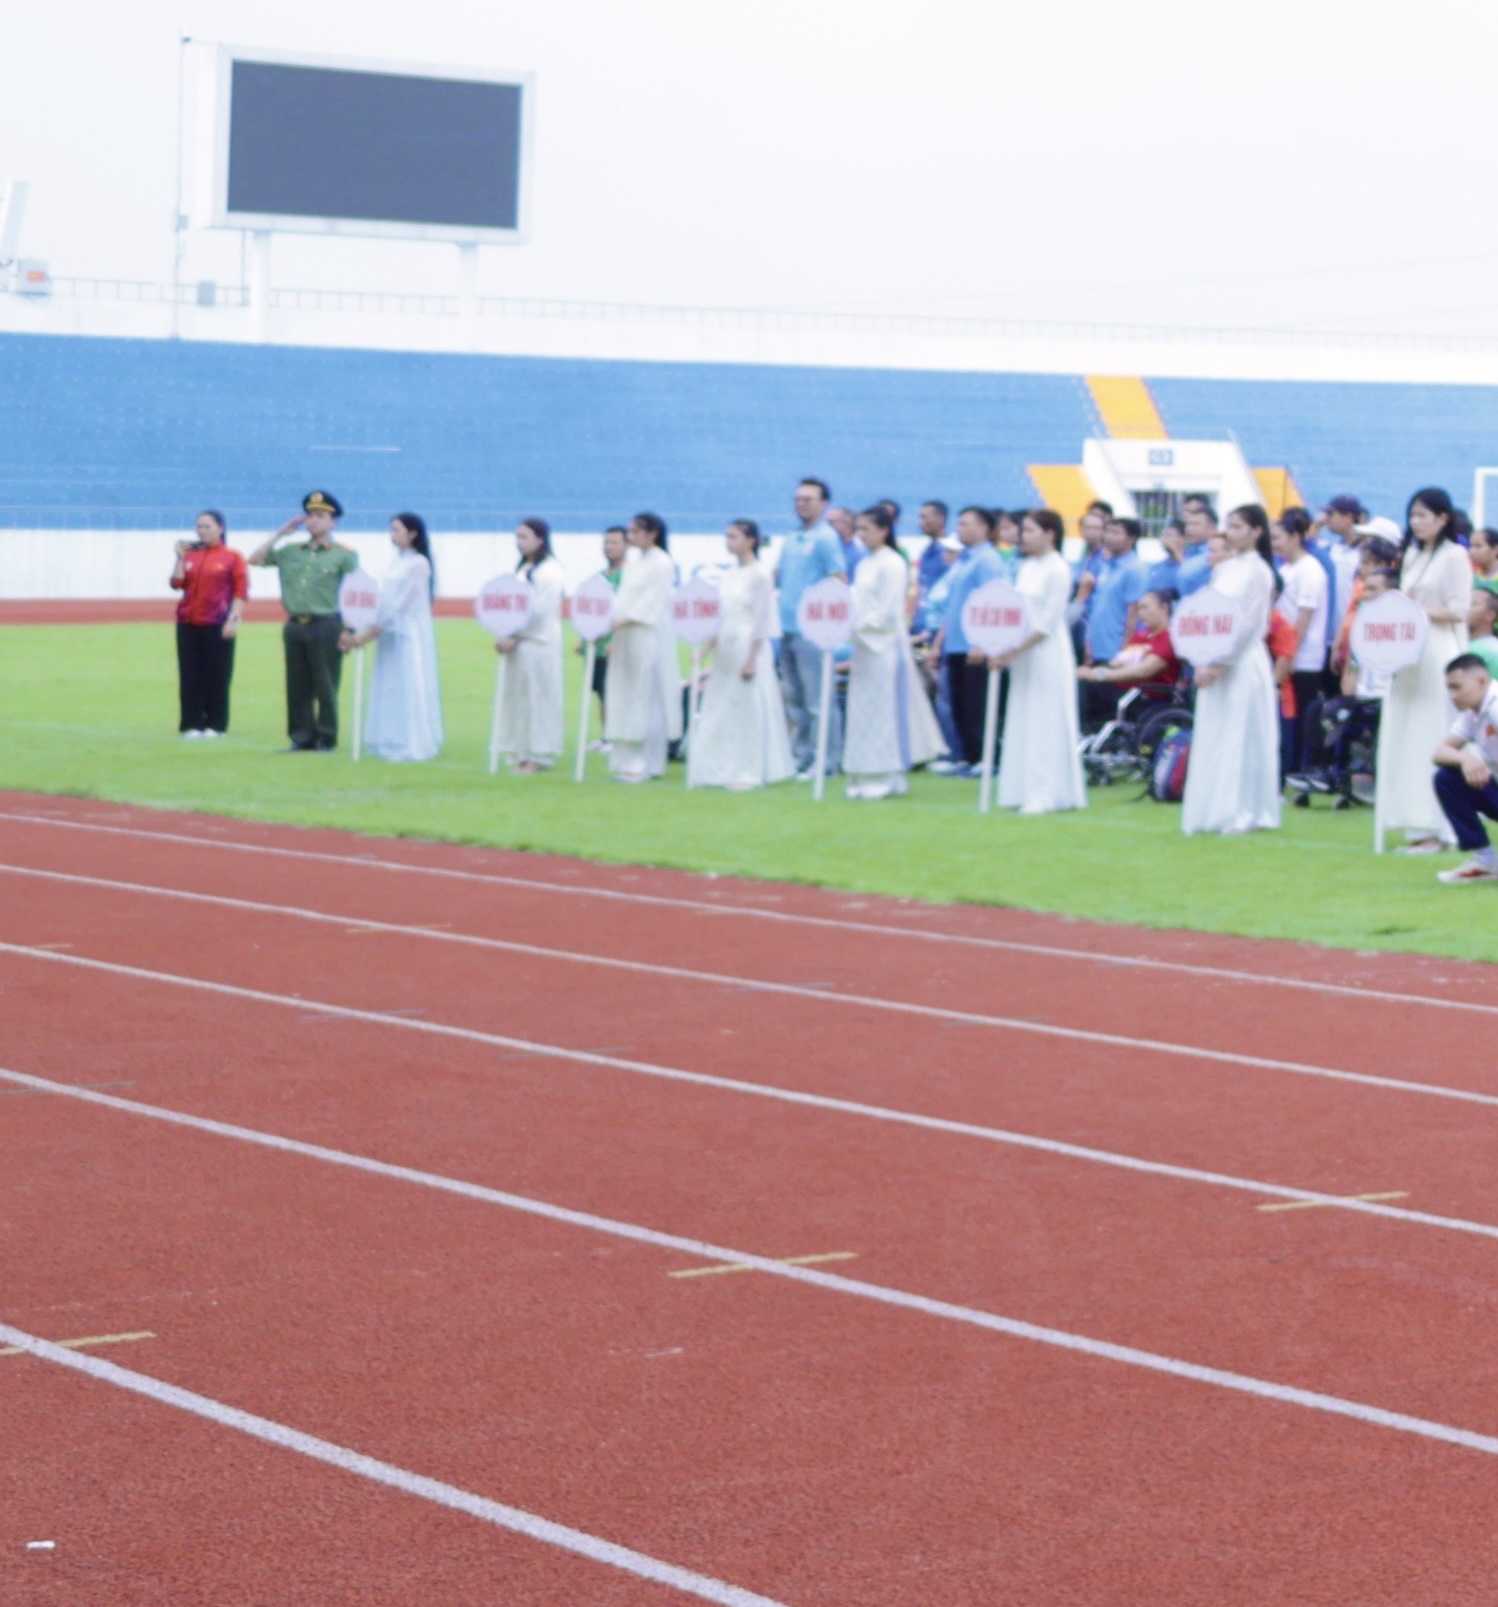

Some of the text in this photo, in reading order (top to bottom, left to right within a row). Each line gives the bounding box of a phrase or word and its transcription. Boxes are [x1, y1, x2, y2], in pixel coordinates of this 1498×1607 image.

[1178, 607, 1233, 637] ĐỒNG NAI
[1363, 622, 1397, 646] TRỌNG
